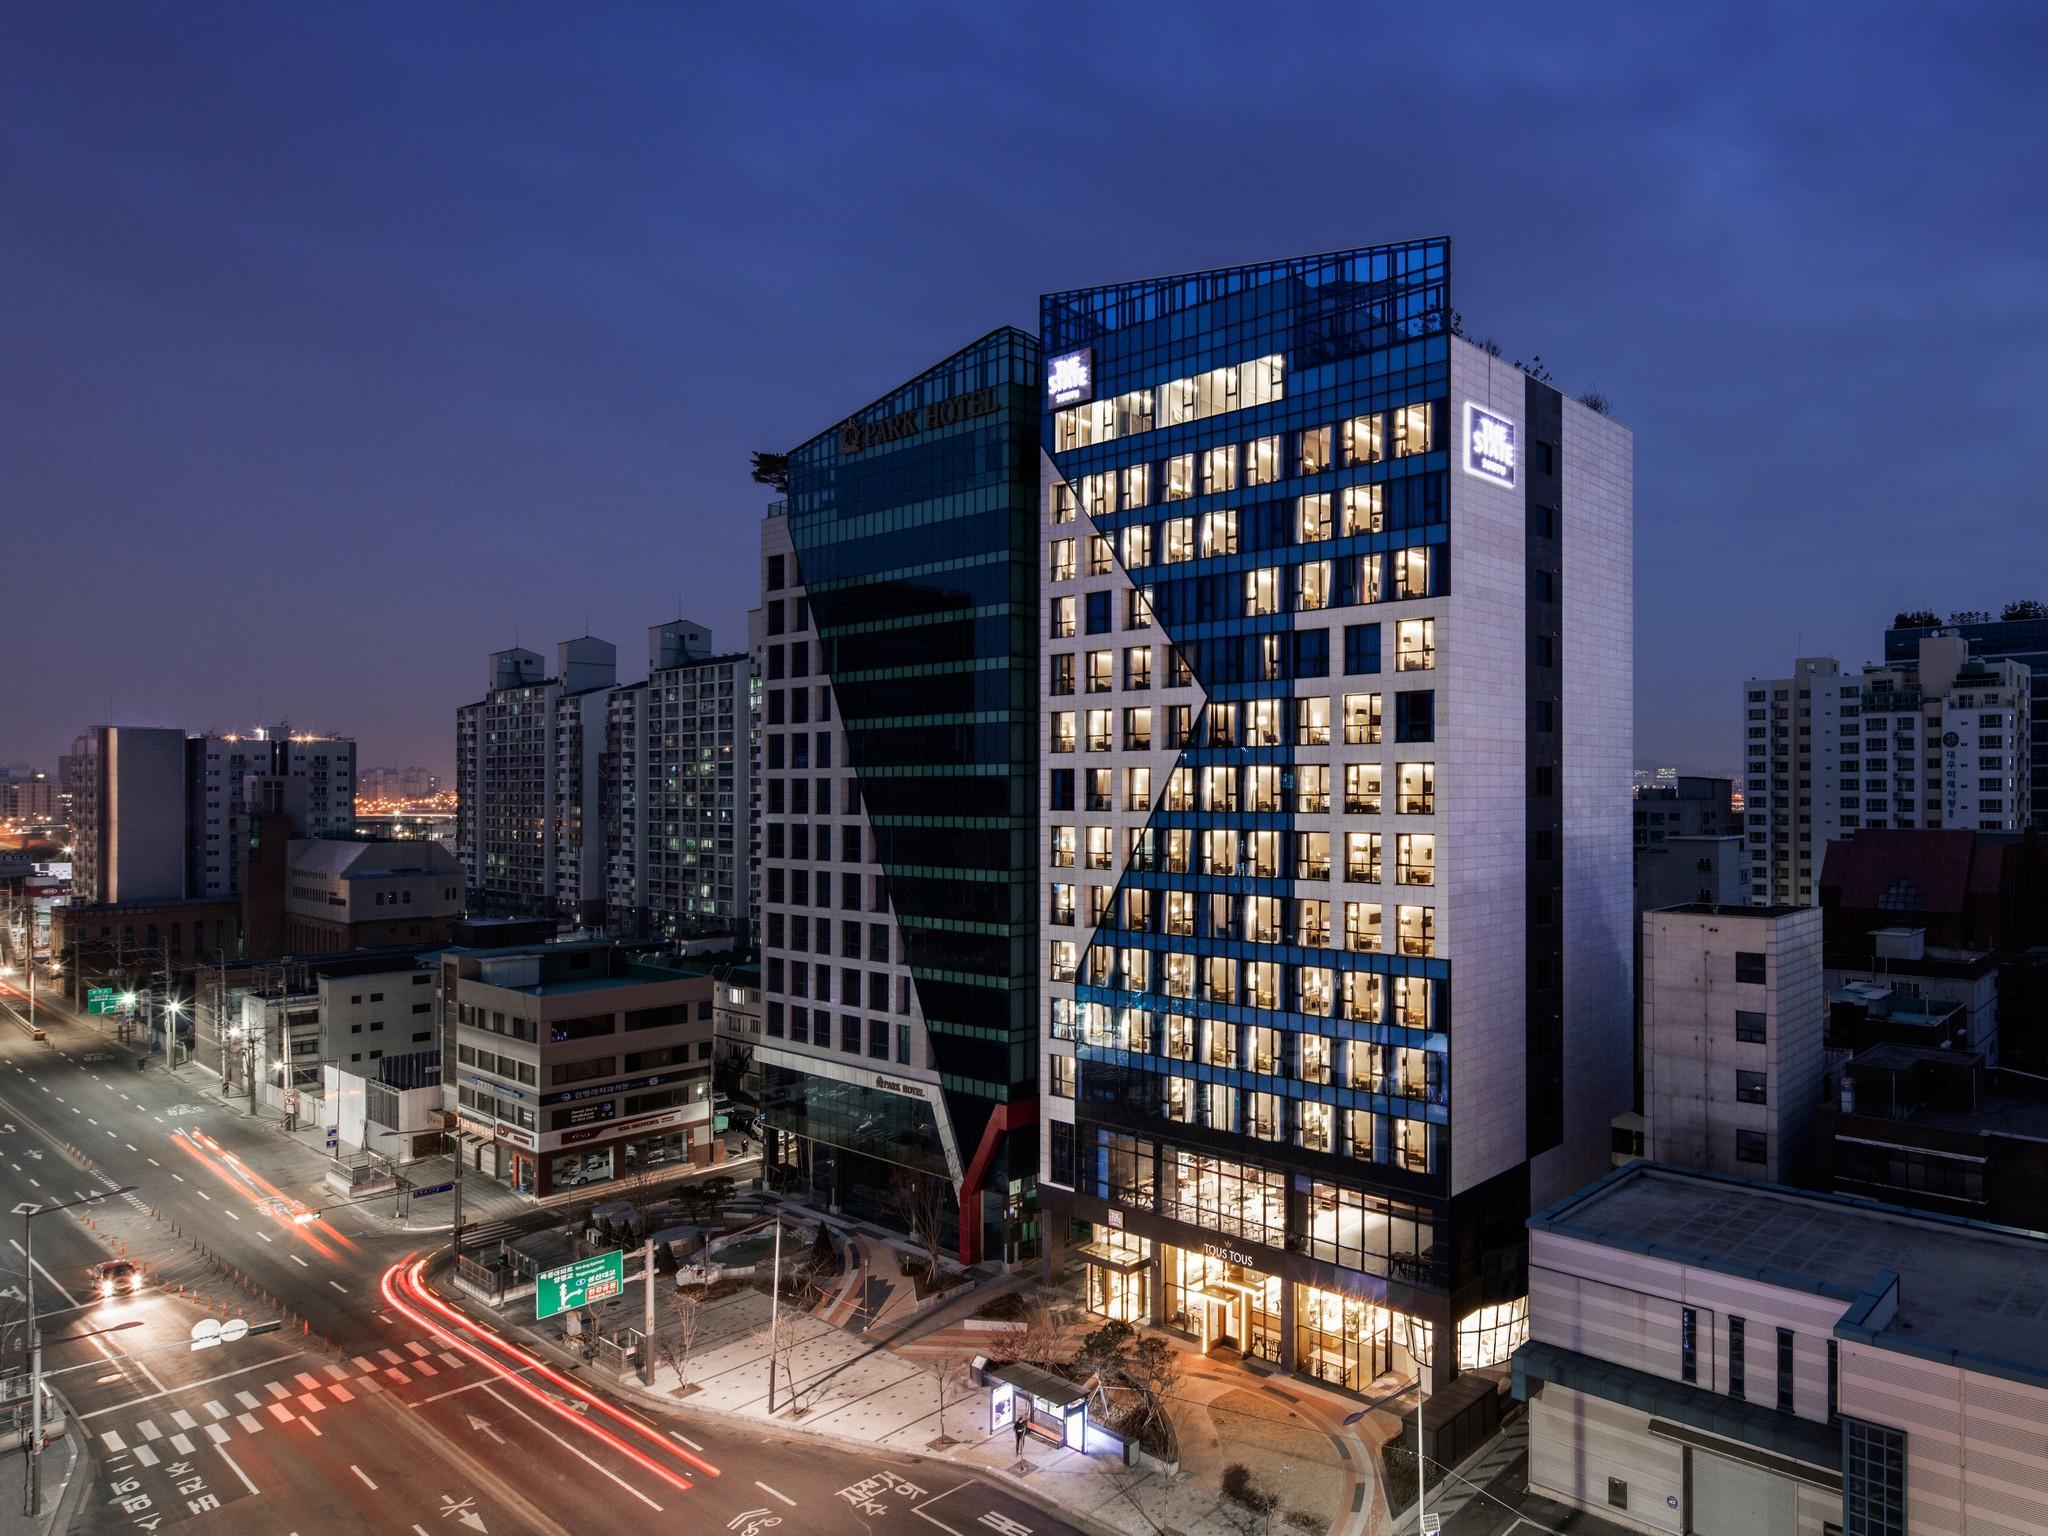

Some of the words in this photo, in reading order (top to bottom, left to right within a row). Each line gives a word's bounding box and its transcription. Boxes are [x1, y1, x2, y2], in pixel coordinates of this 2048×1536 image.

[864, 409, 919, 447] PARK
[926, 387, 1001, 429] HOTEL
[1473, 430, 1514, 466] STATE
[883, 1080, 901, 1092] PARK
[902, 1084, 925, 1097] HOTEL
[1203, 1243, 1227, 1259] TOUS
[1229, 1250, 1253, 1267] TOUS
[834, 1470, 906, 1506] 자전거
